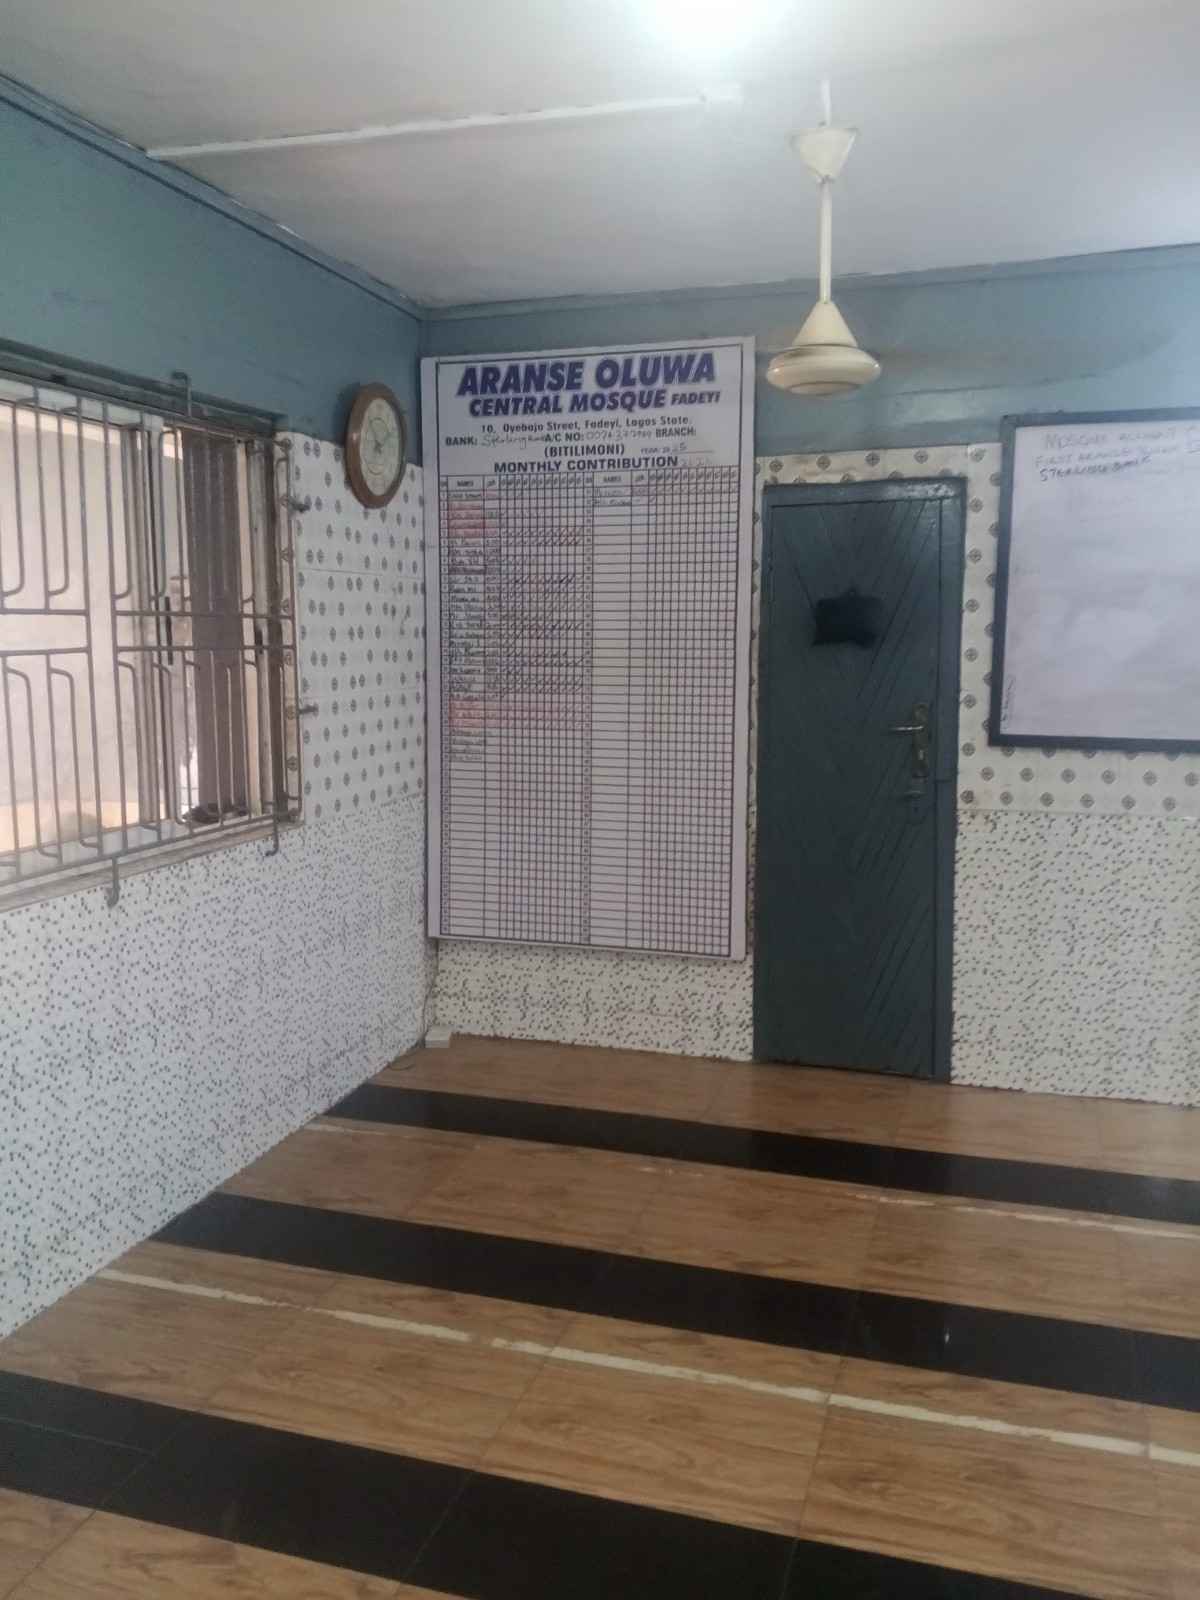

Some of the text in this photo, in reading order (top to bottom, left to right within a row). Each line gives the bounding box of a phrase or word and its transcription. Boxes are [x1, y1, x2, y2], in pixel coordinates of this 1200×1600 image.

[457, 352, 715, 396] ARANSE OLUWA
[469, 389, 721, 416] CENTRAL MOSQUE FADEYI
[626, 417, 656, 427] Lagos
[445, 436, 478, 447] BANK:
[544, 441, 625, 458] (BITILIMONI)
[494, 459, 562, 473] MONTHLY
[567, 453, 679, 471] CONTRIBUTION
